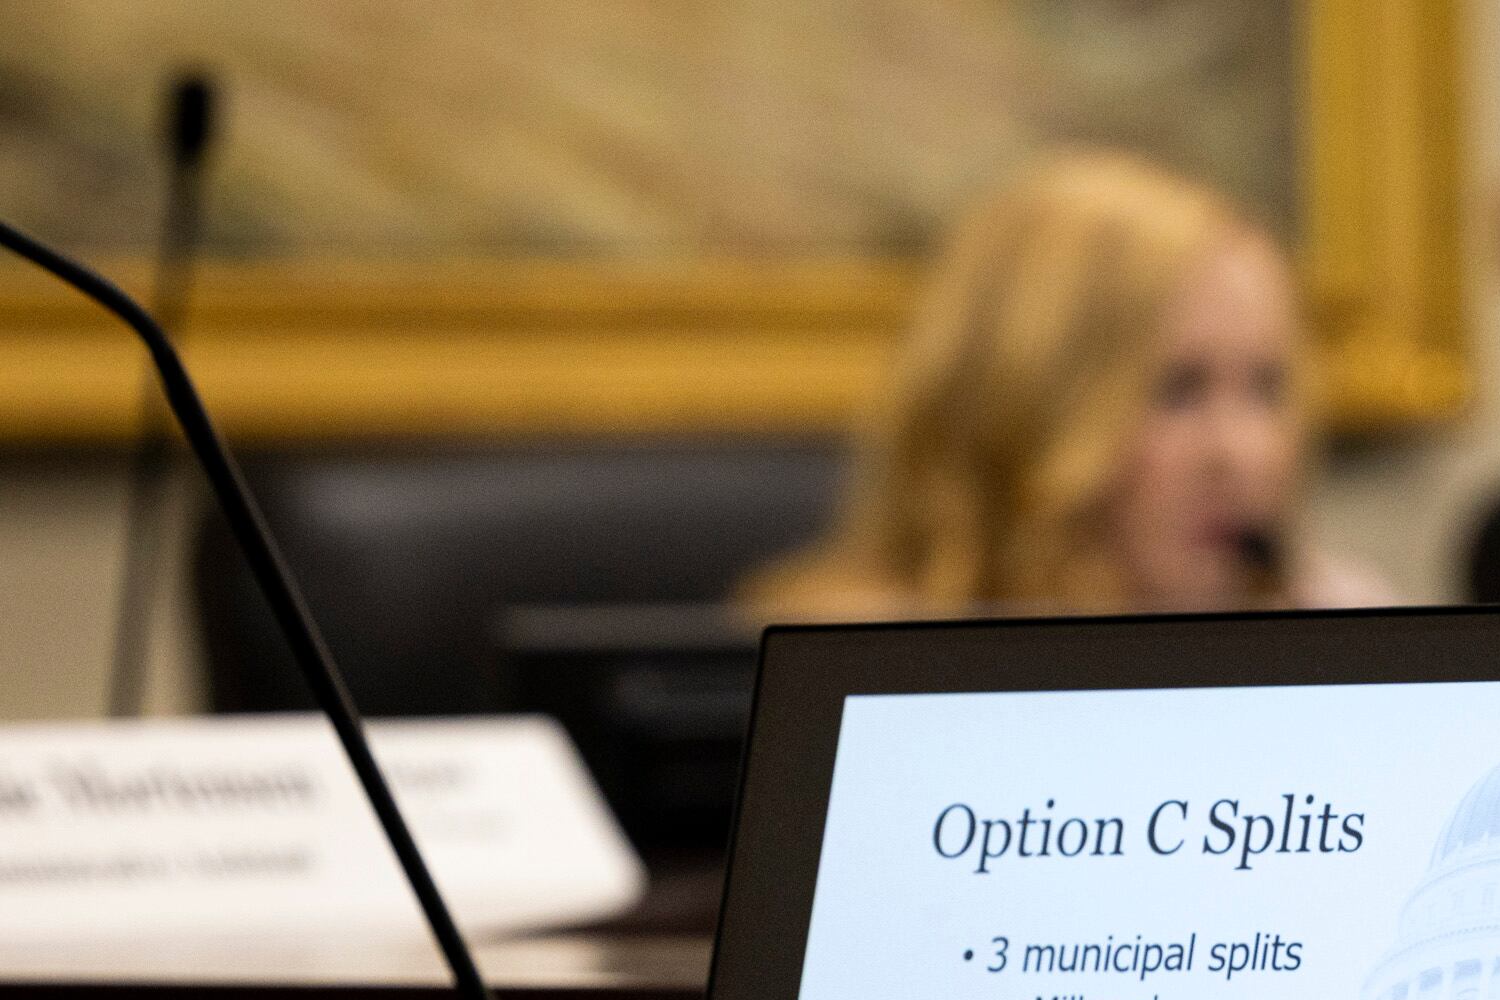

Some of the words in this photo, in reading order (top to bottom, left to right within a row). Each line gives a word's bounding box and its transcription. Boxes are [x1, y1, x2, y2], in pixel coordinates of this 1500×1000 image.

[932, 799, 1125, 874] Option
[1147, 799, 1189, 855] C
[1202, 794, 1365, 870] Splits
[986, 936, 1010, 973] 3
[1022, 933, 1196, 980] municipal
[1207, 932, 1303, 980] splits
